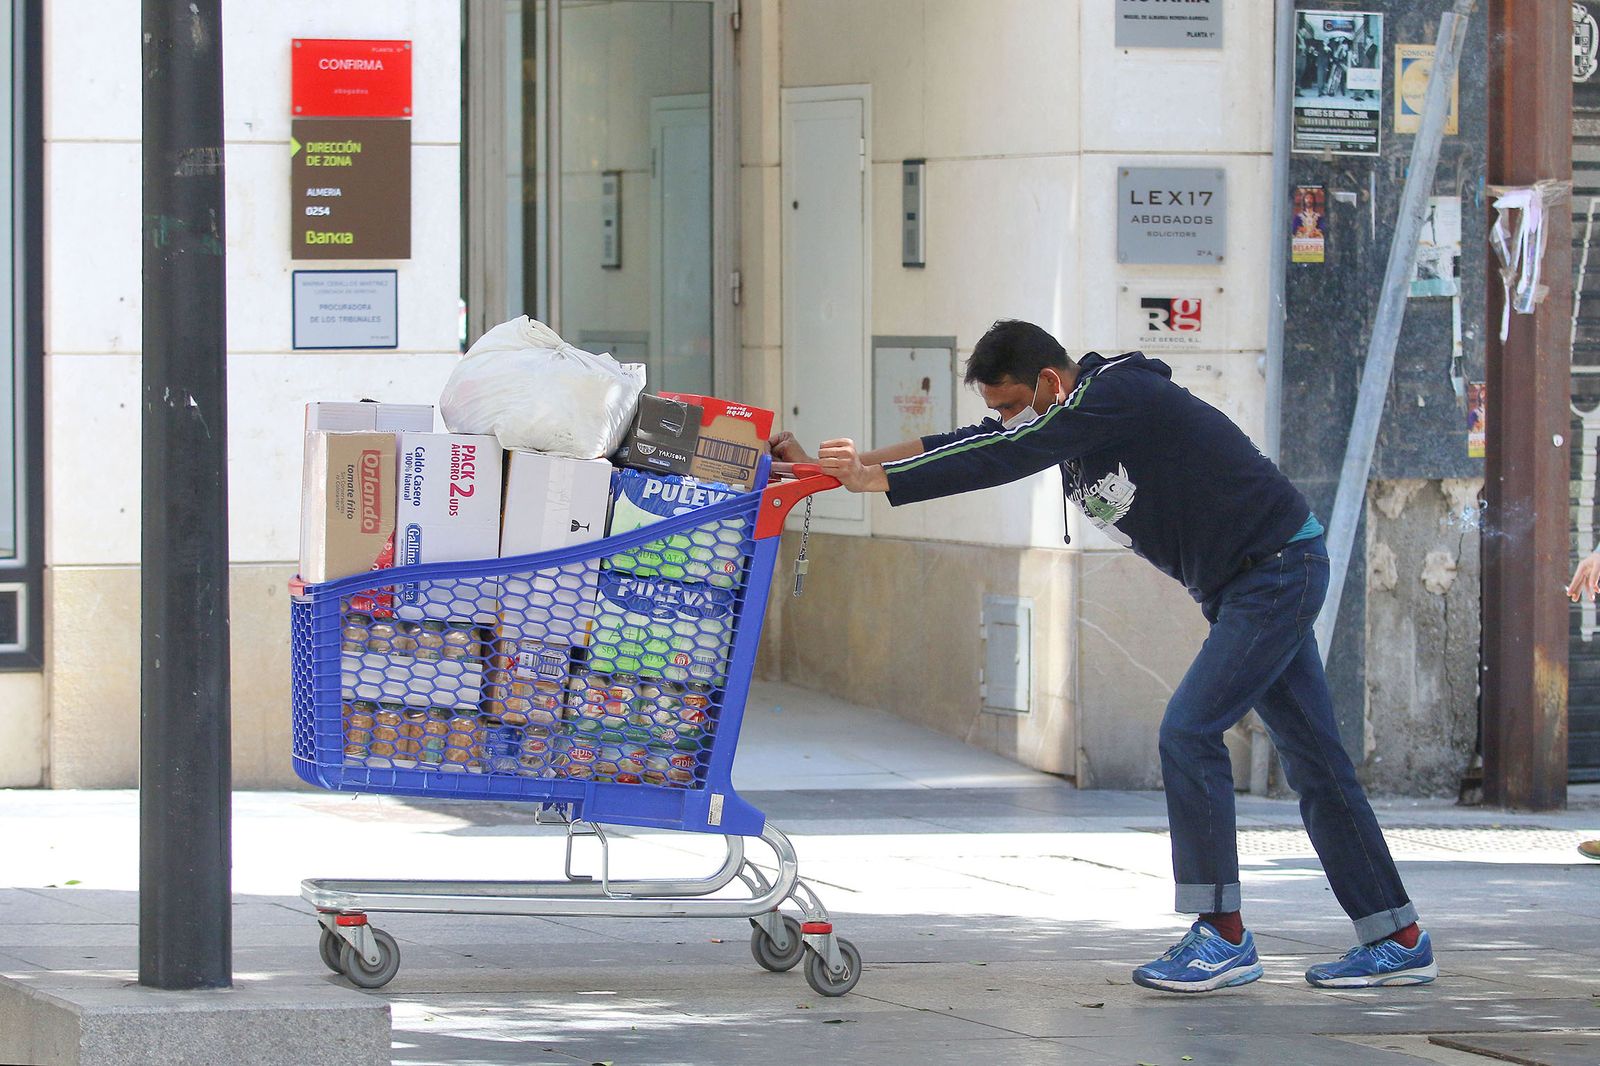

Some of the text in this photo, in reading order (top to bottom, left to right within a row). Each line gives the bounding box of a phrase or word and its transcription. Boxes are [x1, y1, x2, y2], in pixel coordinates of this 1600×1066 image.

[319, 59, 384, 71] CONFIRMA
[306, 140, 361, 153] DIRECCIÓN
[306, 156, 352, 167] DE ZONA
[306, 188, 341, 197] ALMERIA
[1131, 190, 1213, 206] LEX17
[305, 206, 330, 216] 0254
[1130, 215, 1213, 225] ABOGADOS
[305, 230, 353, 244] Bankia
[450, 443, 461, 481] AHORRO
[461, 444, 476, 480] PACK
[658, 449, 686, 463] YAKISOBA
[403, 452, 413, 501] 100% Natural
[413, 446, 425, 507] Caldo Casero
[346, 464, 356, 520] tomate frito
[363, 453, 379, 530] Orlando
[449, 482, 475, 517] 2 UDS
[408, 528, 420, 564] Gallina
